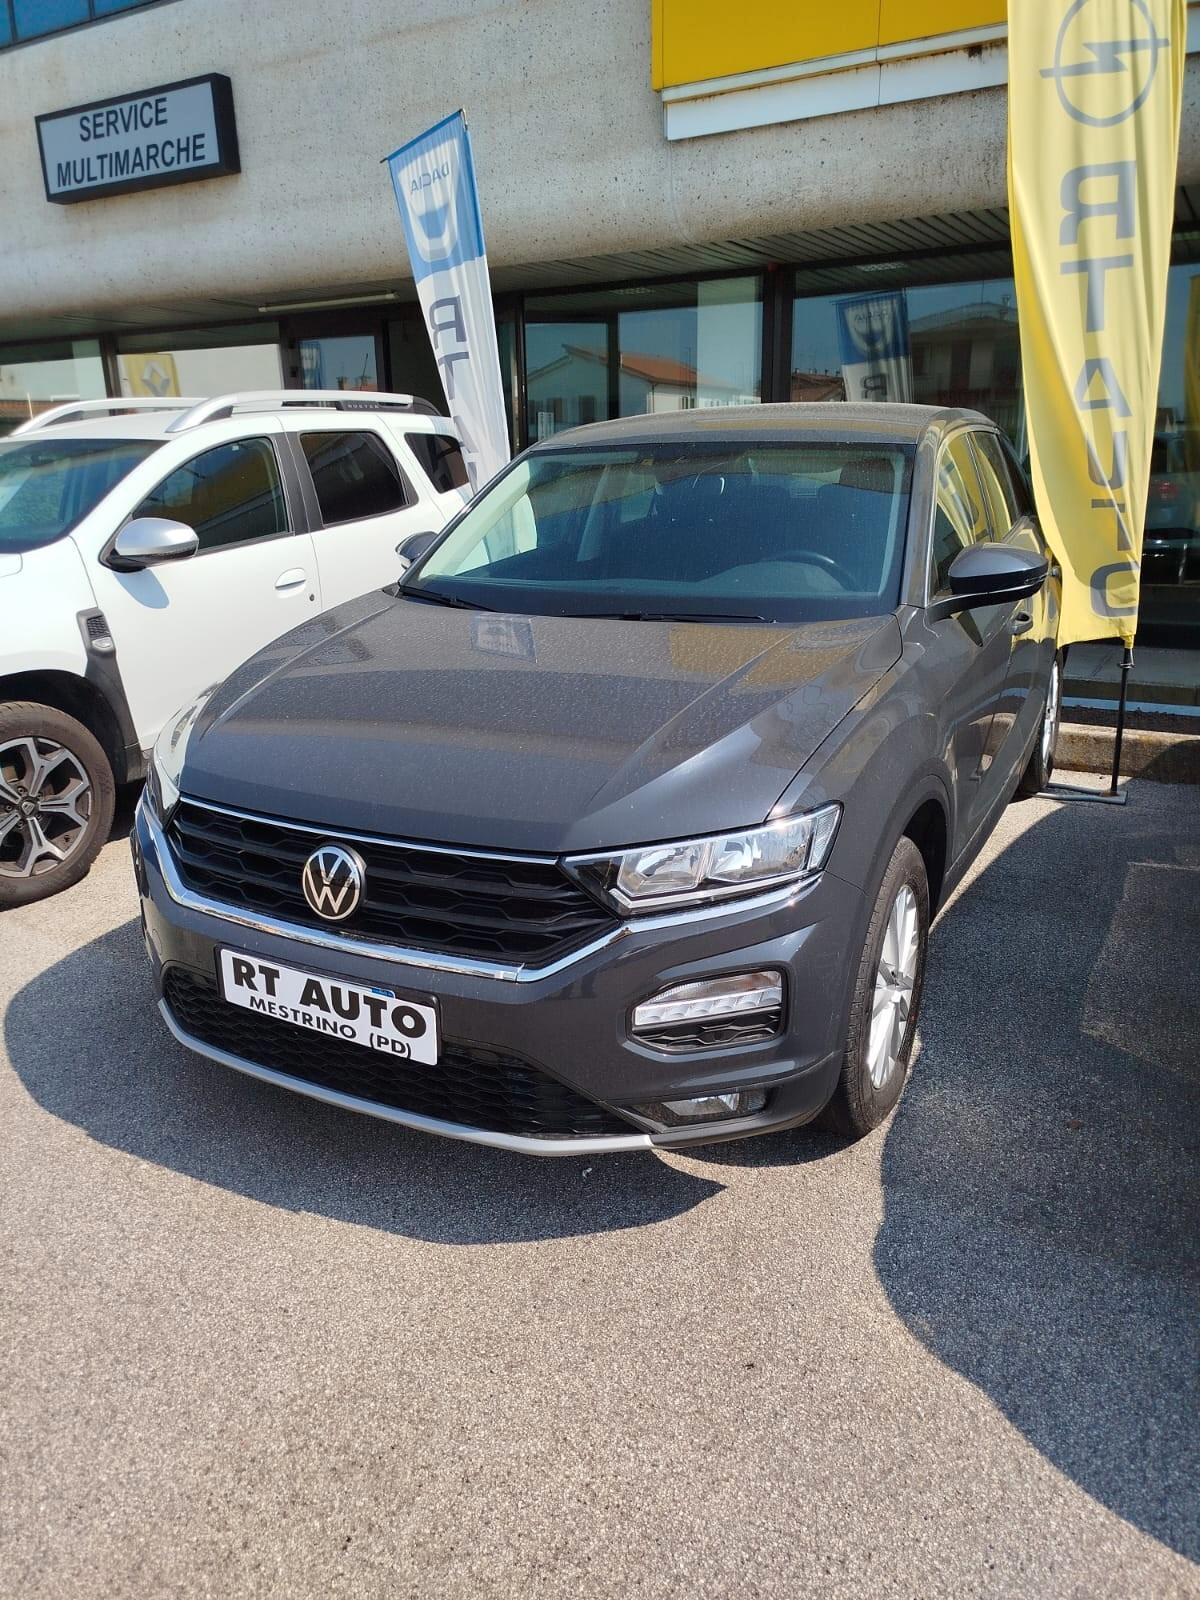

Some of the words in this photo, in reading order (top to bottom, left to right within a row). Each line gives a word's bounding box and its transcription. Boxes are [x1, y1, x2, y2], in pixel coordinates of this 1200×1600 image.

[79, 97, 168, 142] SERVICE
[57, 133, 206, 188] MULTIMARCHE
[231, 956, 280, 997] RT
[299, 978, 427, 1039] AUTO
[249, 995, 357, 1039] MESTRINO
[369, 1032, 412, 1059] (PD)
